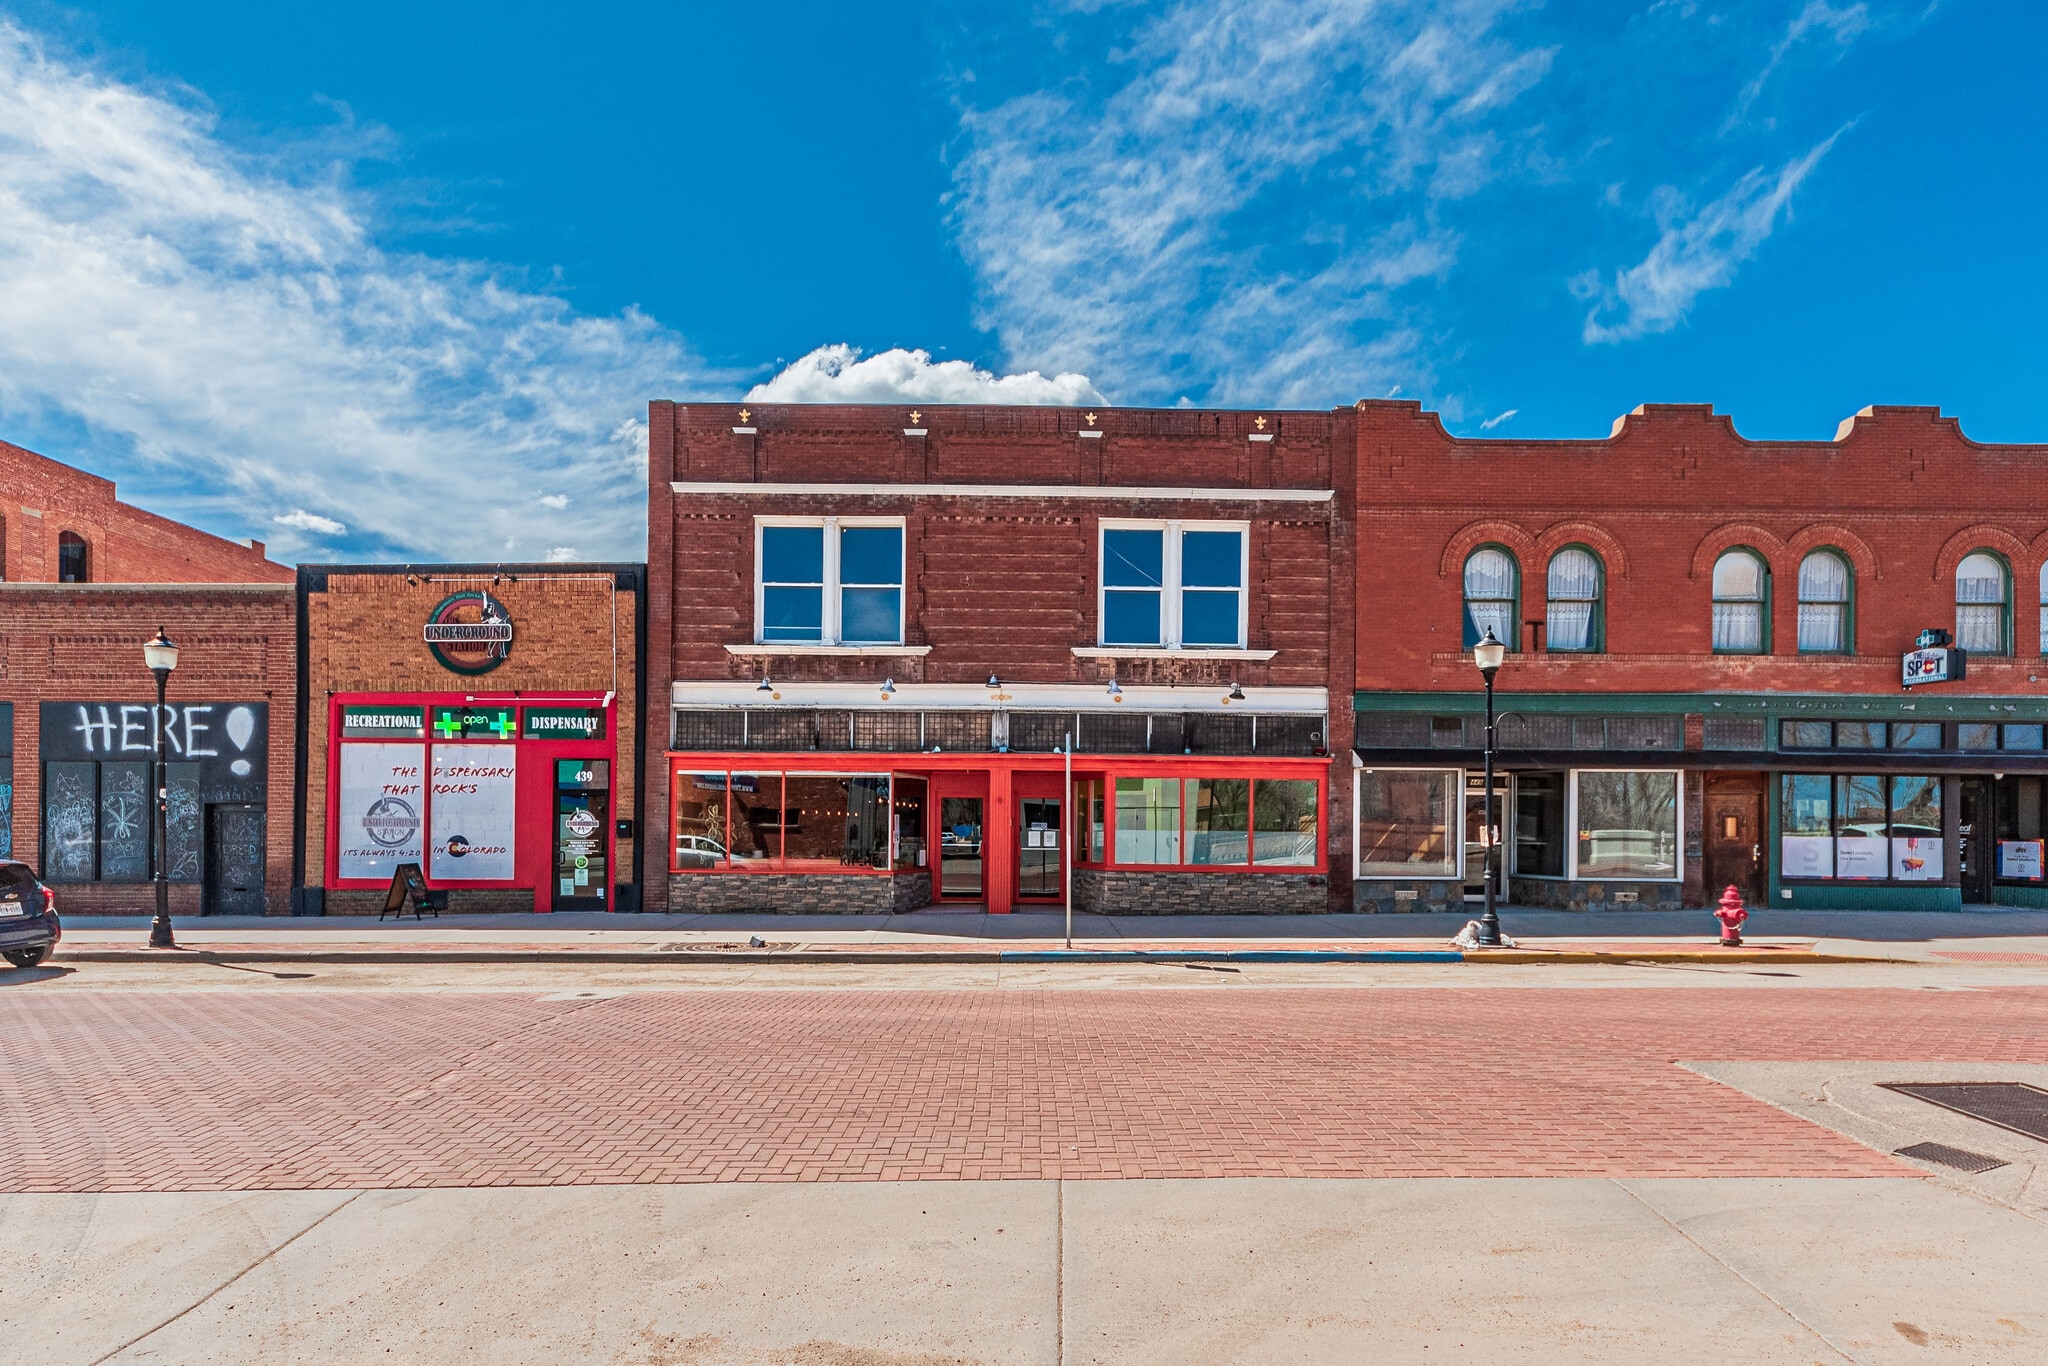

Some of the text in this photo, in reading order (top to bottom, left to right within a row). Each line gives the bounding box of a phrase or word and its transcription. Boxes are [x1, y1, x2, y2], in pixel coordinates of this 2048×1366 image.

[427, 626, 510, 640] UNDERGROUND
[1908, 656, 1944, 677] SPOT
[345, 715, 422, 728] RECREATIONAL
[463, 715, 488, 725] open
[531, 717, 598, 730] DISPENSARY
[392, 767, 418, 777] THE
[433, 767, 514, 778] DSPENSARY
[575, 771, 593, 782] 439
[383, 785, 420, 795] THAT
[432, 784, 478, 794] ROCK'S
[360, 849, 396, 857] ALWAYS
[399, 849, 421, 857] 4:20
[433, 841, 507, 857] IN COLORADO
